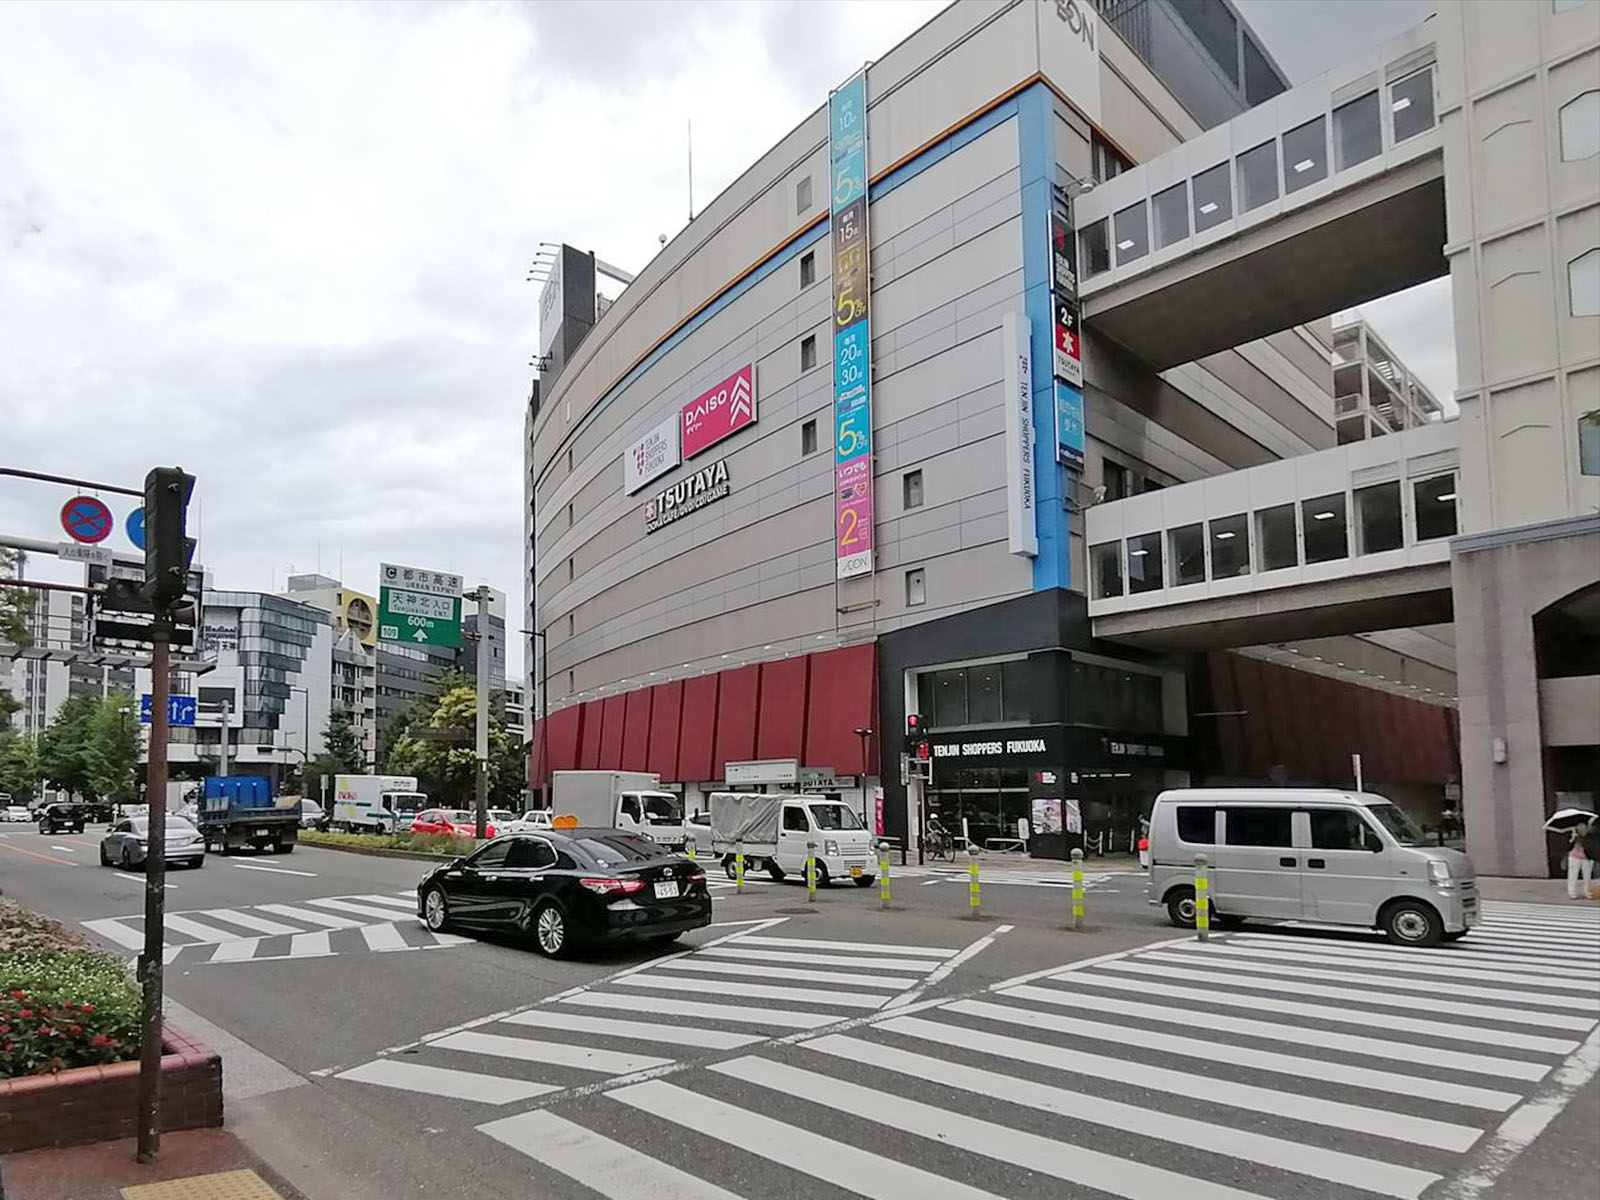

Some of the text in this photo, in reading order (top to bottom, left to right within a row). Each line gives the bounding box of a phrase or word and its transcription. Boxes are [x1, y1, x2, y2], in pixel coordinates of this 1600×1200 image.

[1061, 307, 1074, 327] 2F
[685, 389, 727, 427] DAISO
[1020, 381, 1032, 510] TENJIN SHOPPERS FUKUOKA
[656, 460, 727, 514] TSUTAYA
[403, 569, 458, 588] 都市高速
[383, 626, 397, 637] 109
[407, 615, 434, 629] 600m
[933, 739, 1046, 757] TENJIN SHOPPERS FUKUOKA
